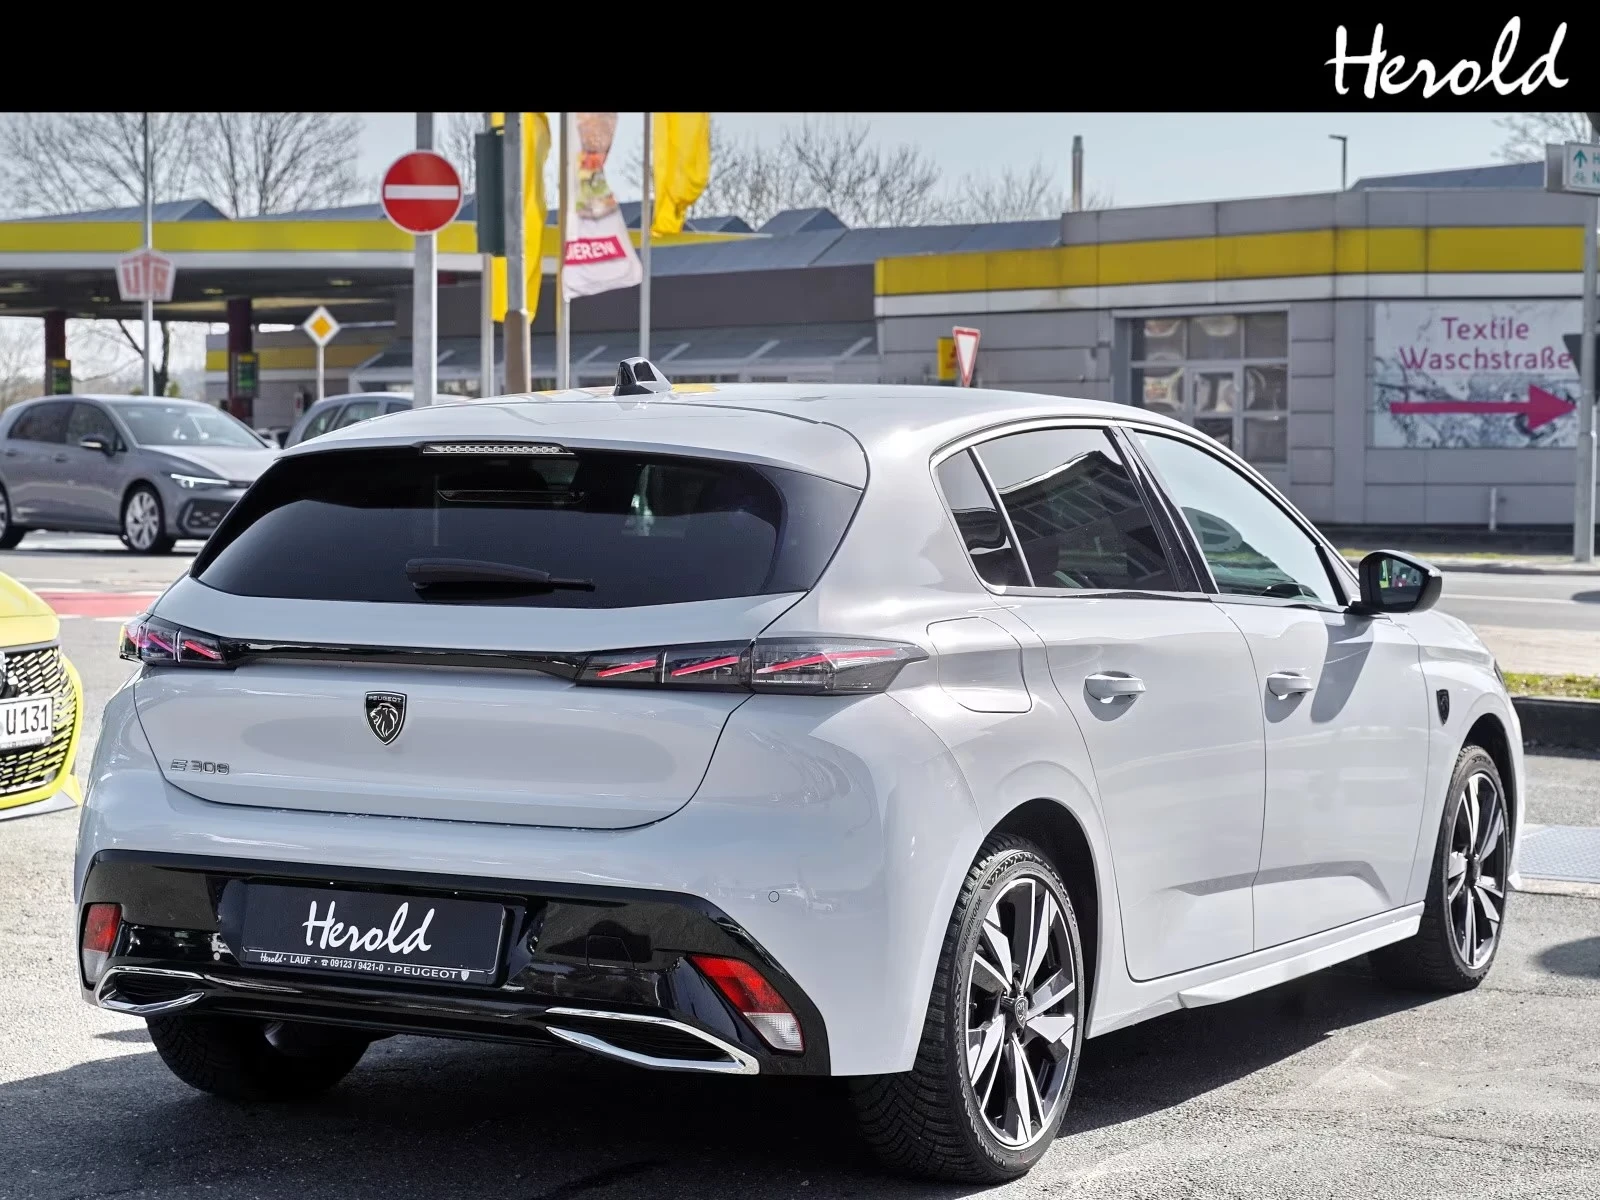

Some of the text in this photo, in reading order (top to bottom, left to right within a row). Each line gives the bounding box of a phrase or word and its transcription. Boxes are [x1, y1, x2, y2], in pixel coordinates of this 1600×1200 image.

[1441, 316, 1530, 340] Textile
[1400, 346, 1574, 370] Waschstraße
[368, 695, 402, 703] PEUGEOT
[6, 704, 49, 736] U 131
[191, 760, 230, 775] 308
[302, 900, 435, 955] Herold
[260, 952, 284, 963] Herold
[290, 955, 311, 965] LAUF
[394, 965, 459, 979] PEUGEOT
